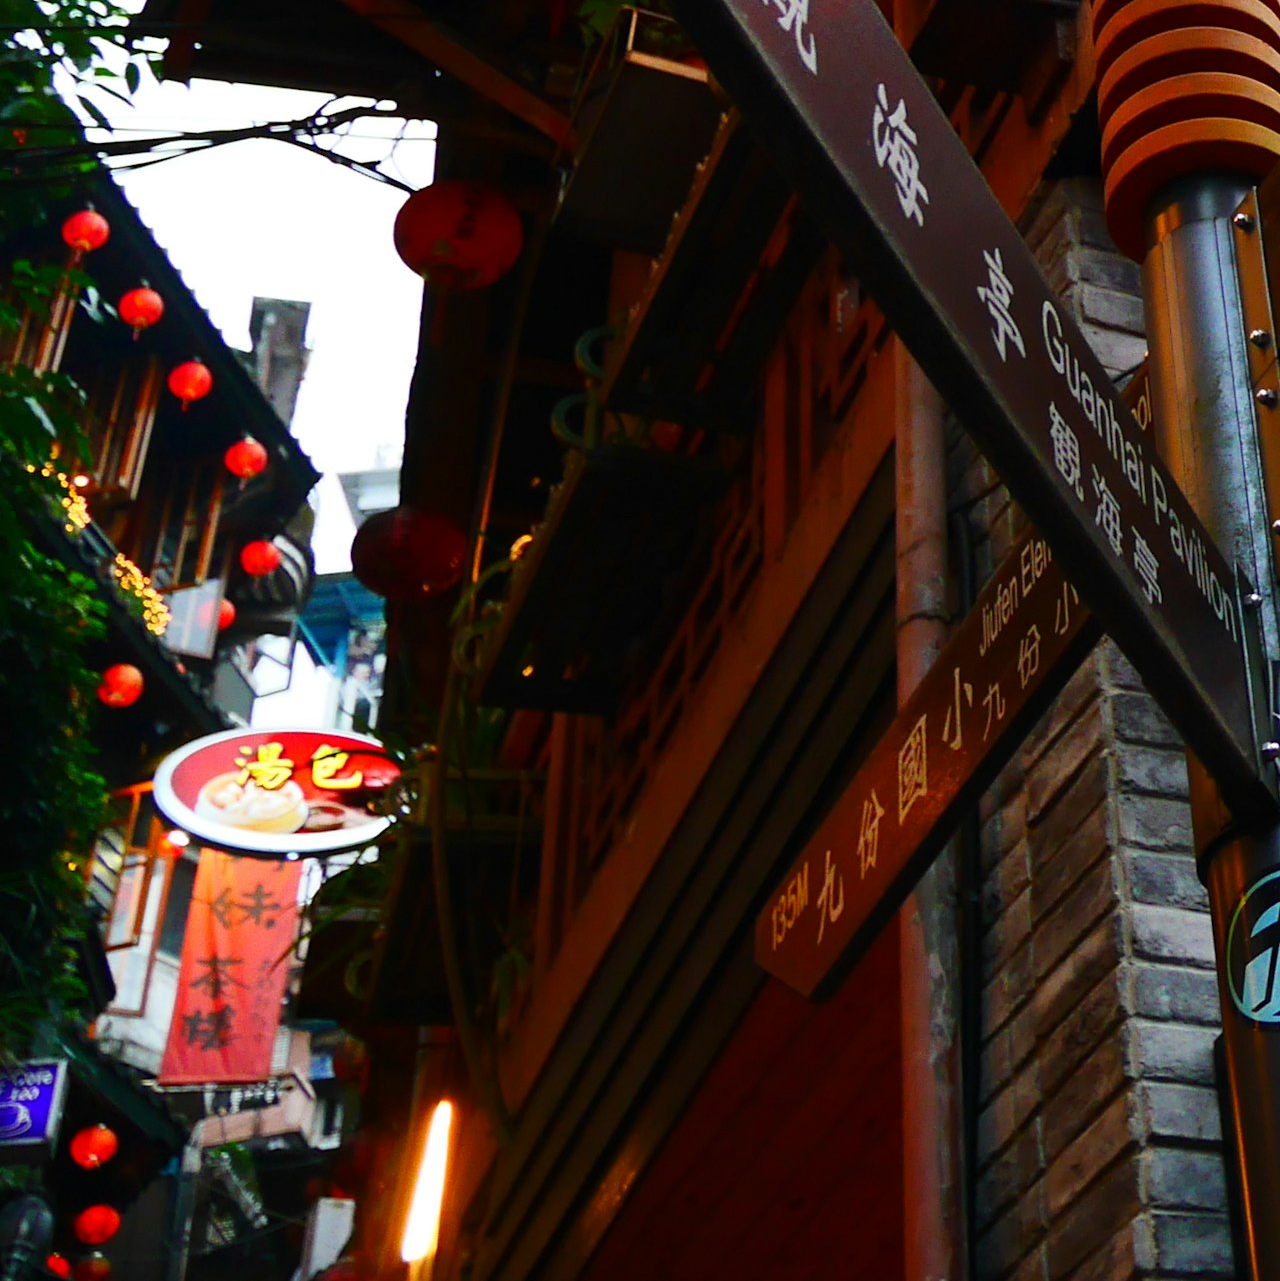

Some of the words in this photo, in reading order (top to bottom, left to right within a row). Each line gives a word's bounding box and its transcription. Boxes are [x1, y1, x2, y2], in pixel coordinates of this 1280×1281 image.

[1043, 300, 1147, 505] Guanhai
[1151, 465, 1237, 642] Pavilion
[979, 576, 1019, 657] Jiufen
[234, 742, 363, 790] 湯包
[817, 668, 972, 945] 九份國小
[773, 862, 808, 950] 135M
